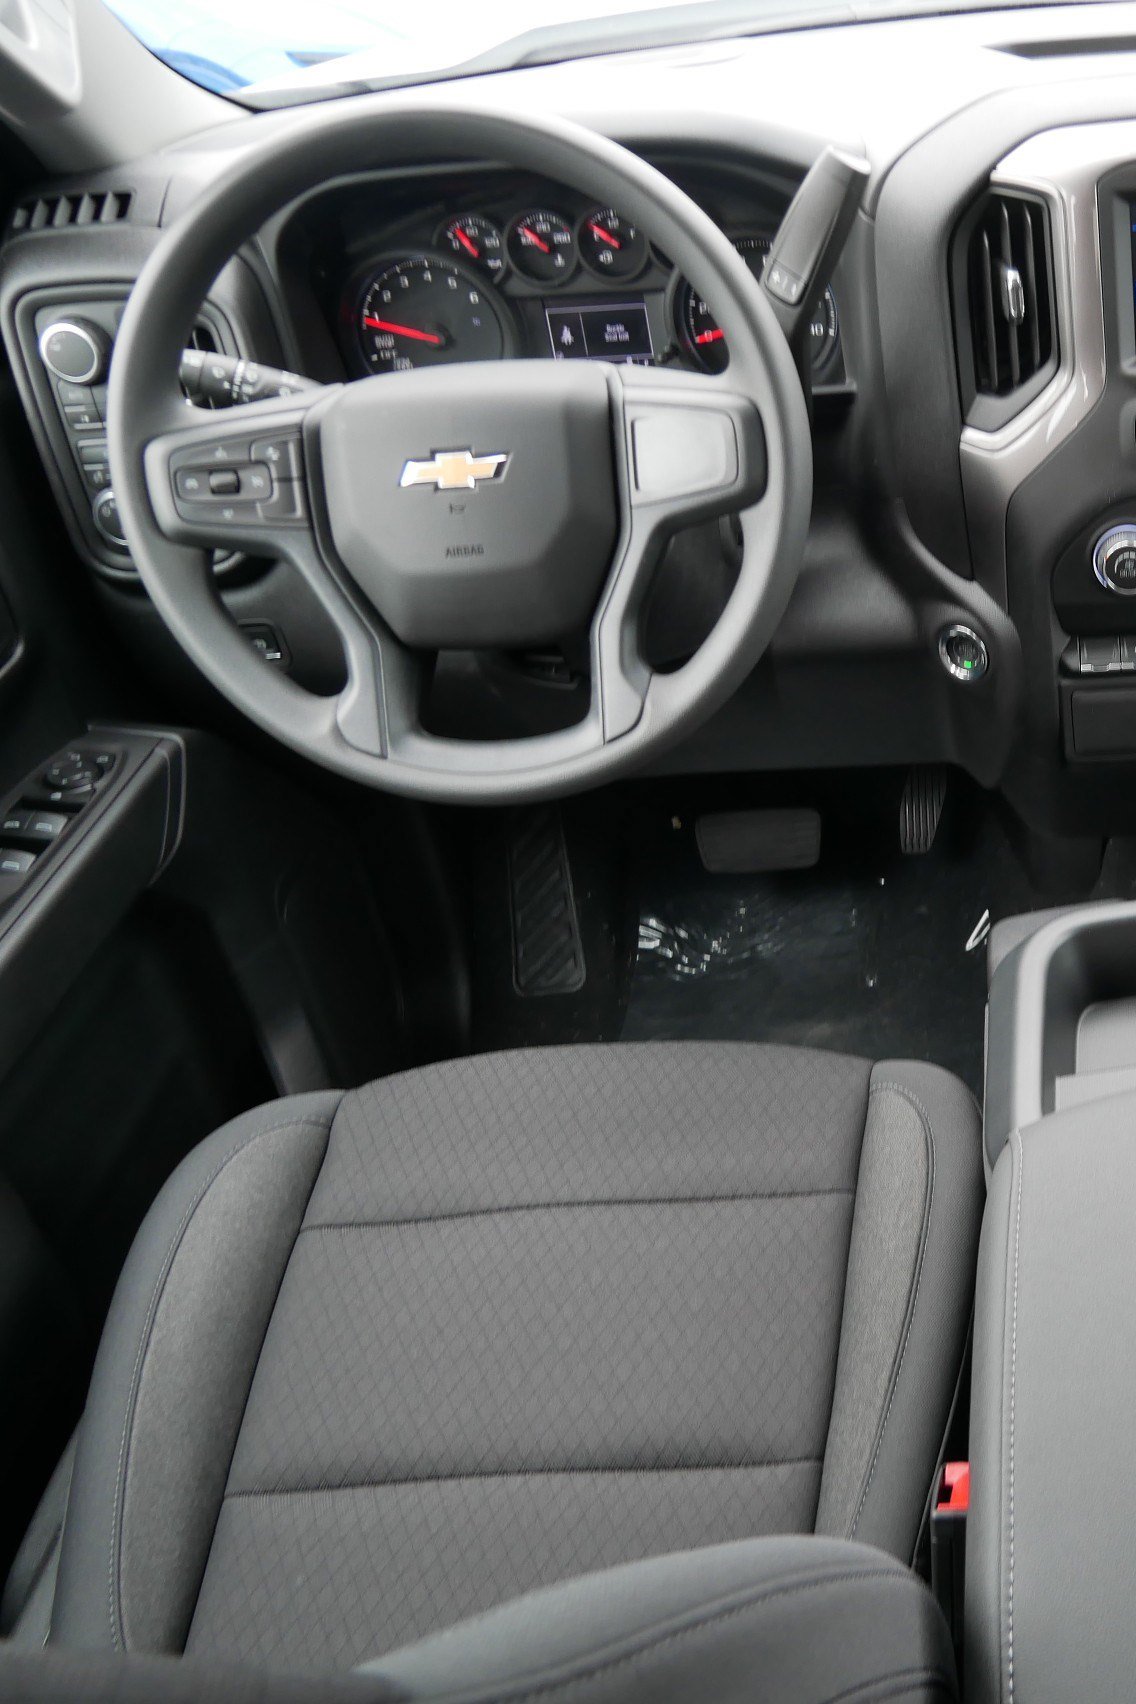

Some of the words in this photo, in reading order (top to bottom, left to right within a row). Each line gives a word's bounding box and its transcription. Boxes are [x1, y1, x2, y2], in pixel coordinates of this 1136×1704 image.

[423, 269, 432, 284] 4
[447, 275, 458, 290] 5
[469, 291, 479, 305] 6
[445, 544, 485, 558] AIRBAG
